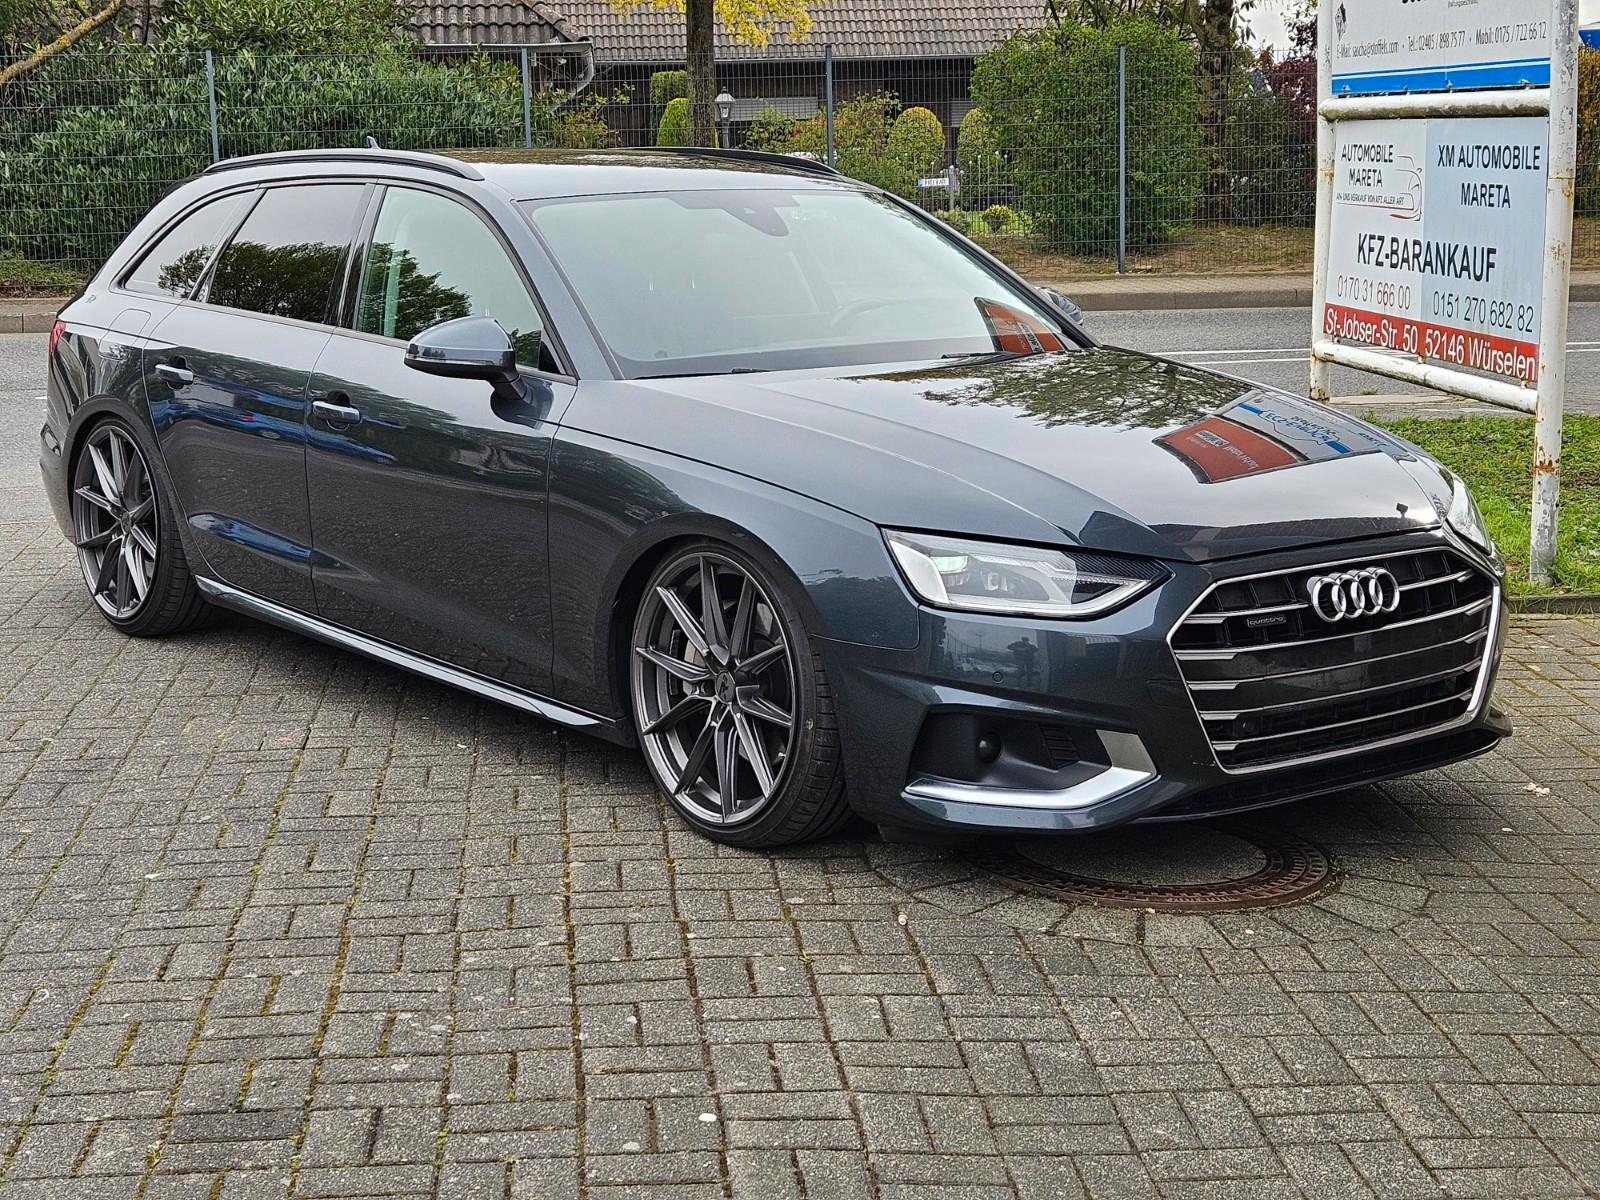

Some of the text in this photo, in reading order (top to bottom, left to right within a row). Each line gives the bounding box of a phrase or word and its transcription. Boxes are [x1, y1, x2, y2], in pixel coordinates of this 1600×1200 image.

[1418, 34, 1434, 51] 02405
[1494, 25, 1510, 43] 0175
[1516, 24, 1528, 41] 722
[1528, 22, 1538, 40] 66
[1538, 21, 1547, 39] 12
[1342, 144, 1394, 163] AUTOMOBILE
[1437, 144, 1541, 171] XM AUTOMOBILE
[1348, 168, 1383, 188] MARETA
[1460, 183, 1511, 209] MARETA
[1357, 232, 1497, 283] KFZ-BARANKAUF
[1337, 274, 1412, 310] 0170 31 666 00
[1433, 290, 1535, 333] 0151 270 682 82
[1326, 308, 1537, 381] St-Jobser-Str. 50 52146 Würselen
[1250, 617, 1283, 626] quattro
